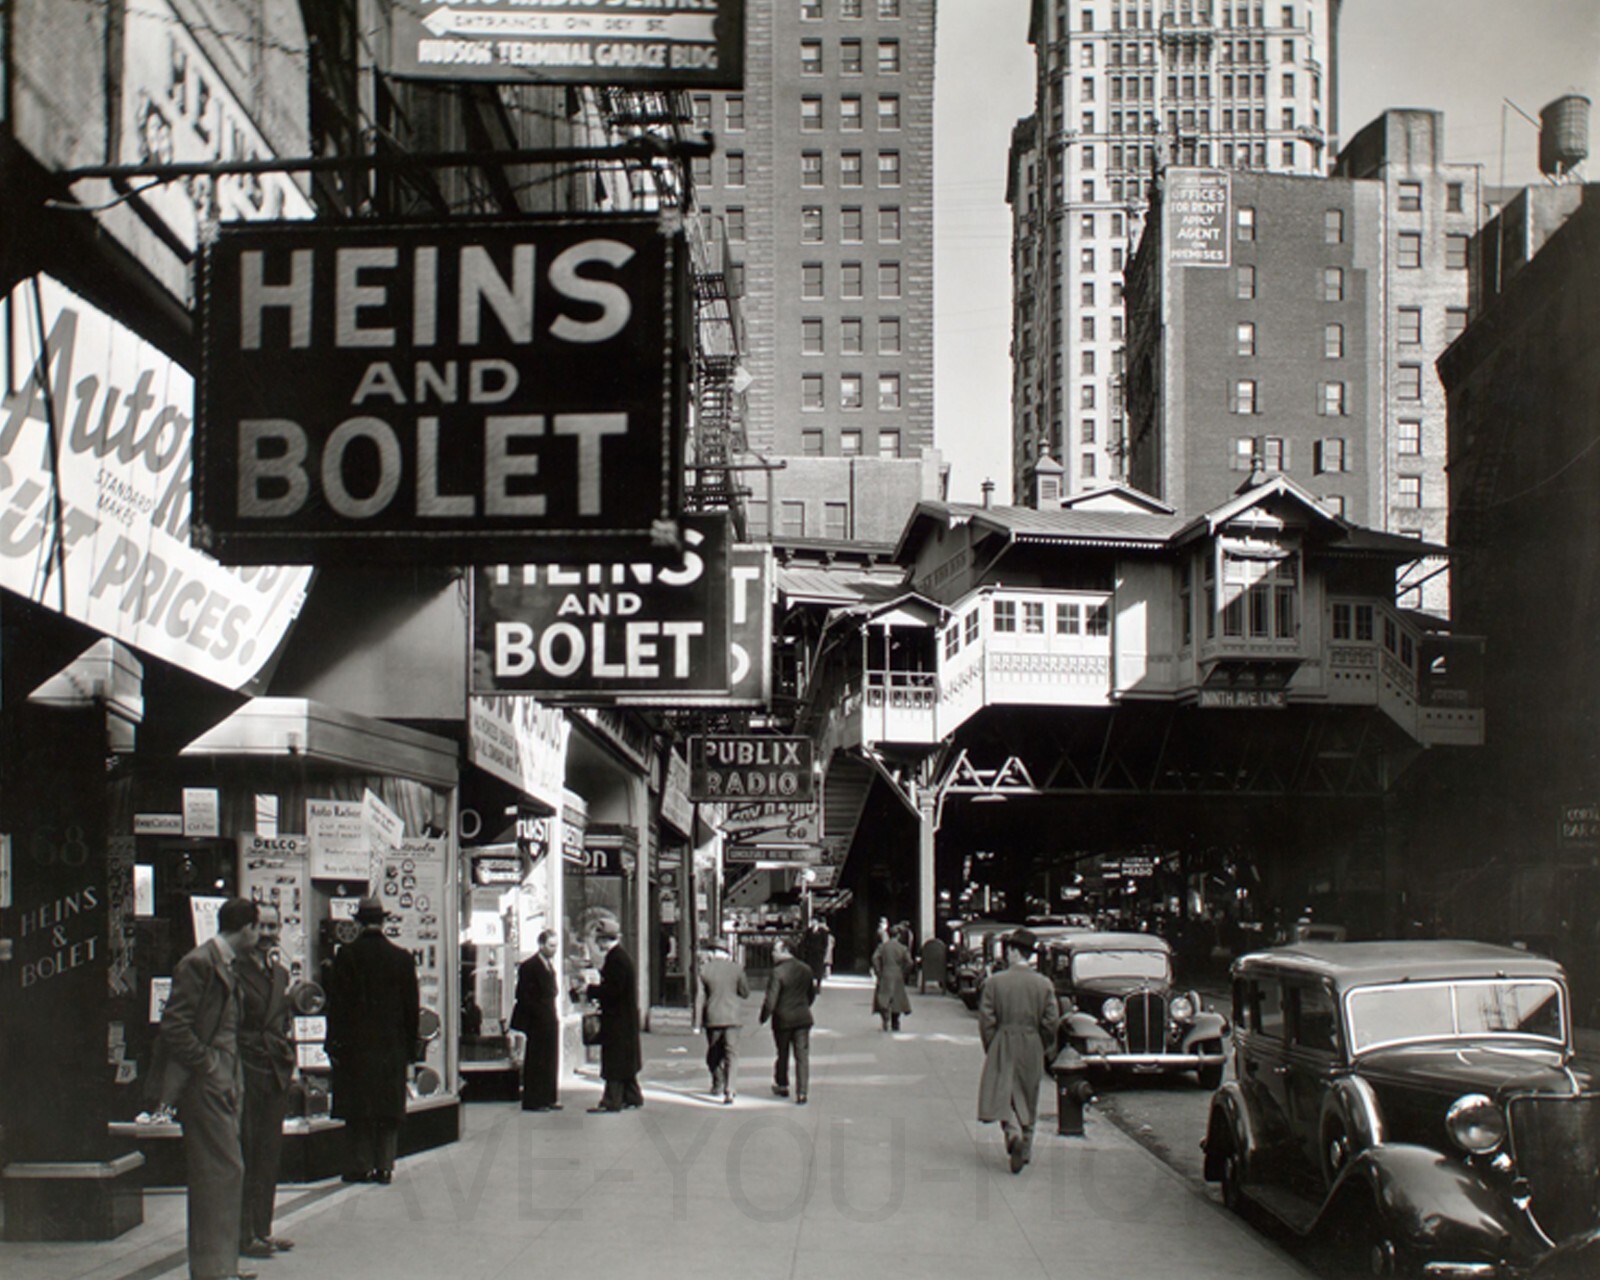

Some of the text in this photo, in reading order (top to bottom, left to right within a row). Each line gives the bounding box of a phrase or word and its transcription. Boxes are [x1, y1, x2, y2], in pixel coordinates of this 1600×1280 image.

[566, 18, 591, 29] ON
[418, 40, 492, 64] HUDSON
[497, 41, 594, 67] TERMINAL
[595, 43, 667, 67] GARAGE
[1177, 228, 1220, 239] AGENT
[240, 239, 636, 351] HEINS
[352, 359, 519, 404] AND
[237, 412, 628, 518] BOLET
[95, 467, 153, 514] STANDARD
[97, 494, 137, 528] MAKES
[557, 593, 642, 616] AND
[495, 622, 704, 678] BOLET
[1202, 690, 1235, 706] NINTH
[707, 771, 798, 796] RADIO
[253, 838, 297, 851] DELCO
[20, 885, 99, 938] HEINS
[51, 924, 68, 948] &
[21, 935, 98, 988] BOLET
